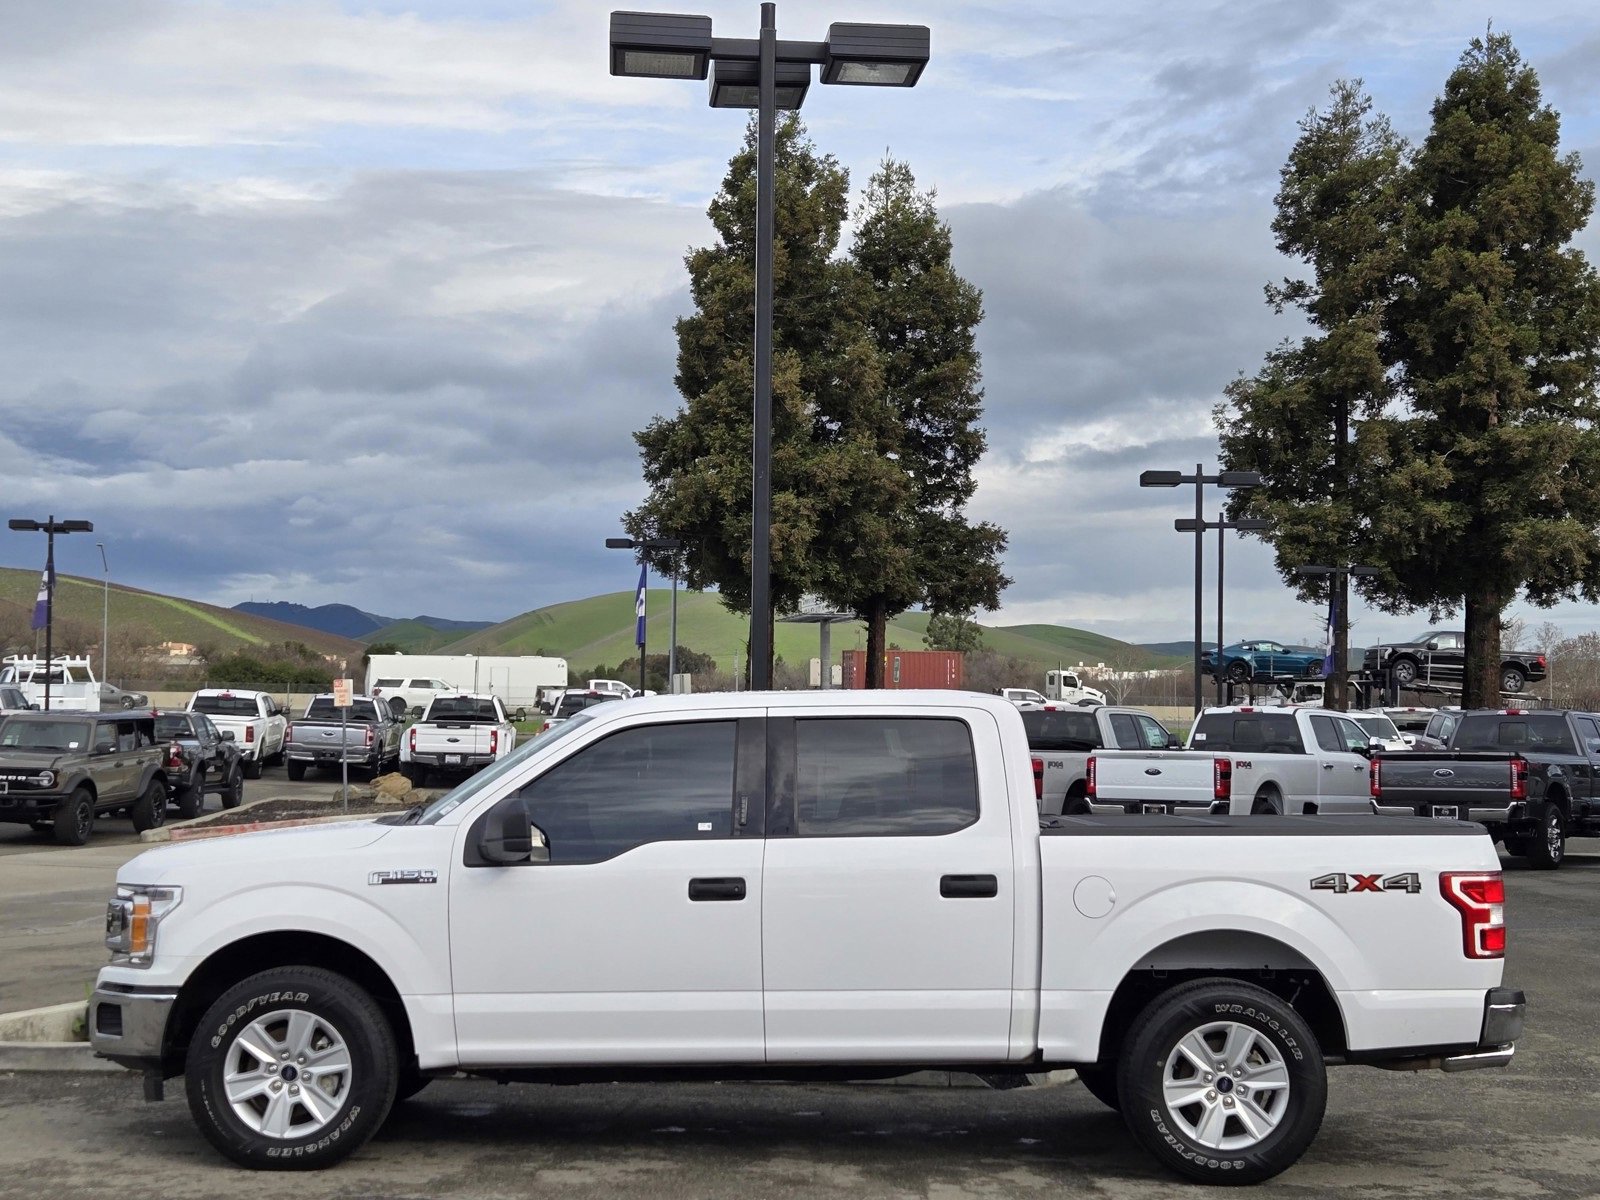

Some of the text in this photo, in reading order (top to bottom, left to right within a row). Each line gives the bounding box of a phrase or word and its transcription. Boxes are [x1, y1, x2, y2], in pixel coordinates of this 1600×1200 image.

[211, 991, 310, 1049] GOODYEAR
[1214, 1003, 1304, 1061] WRANGLER
[266, 1105, 361, 1157] WRANGLER
[1150, 1108, 1246, 1169] GOODYEAR
